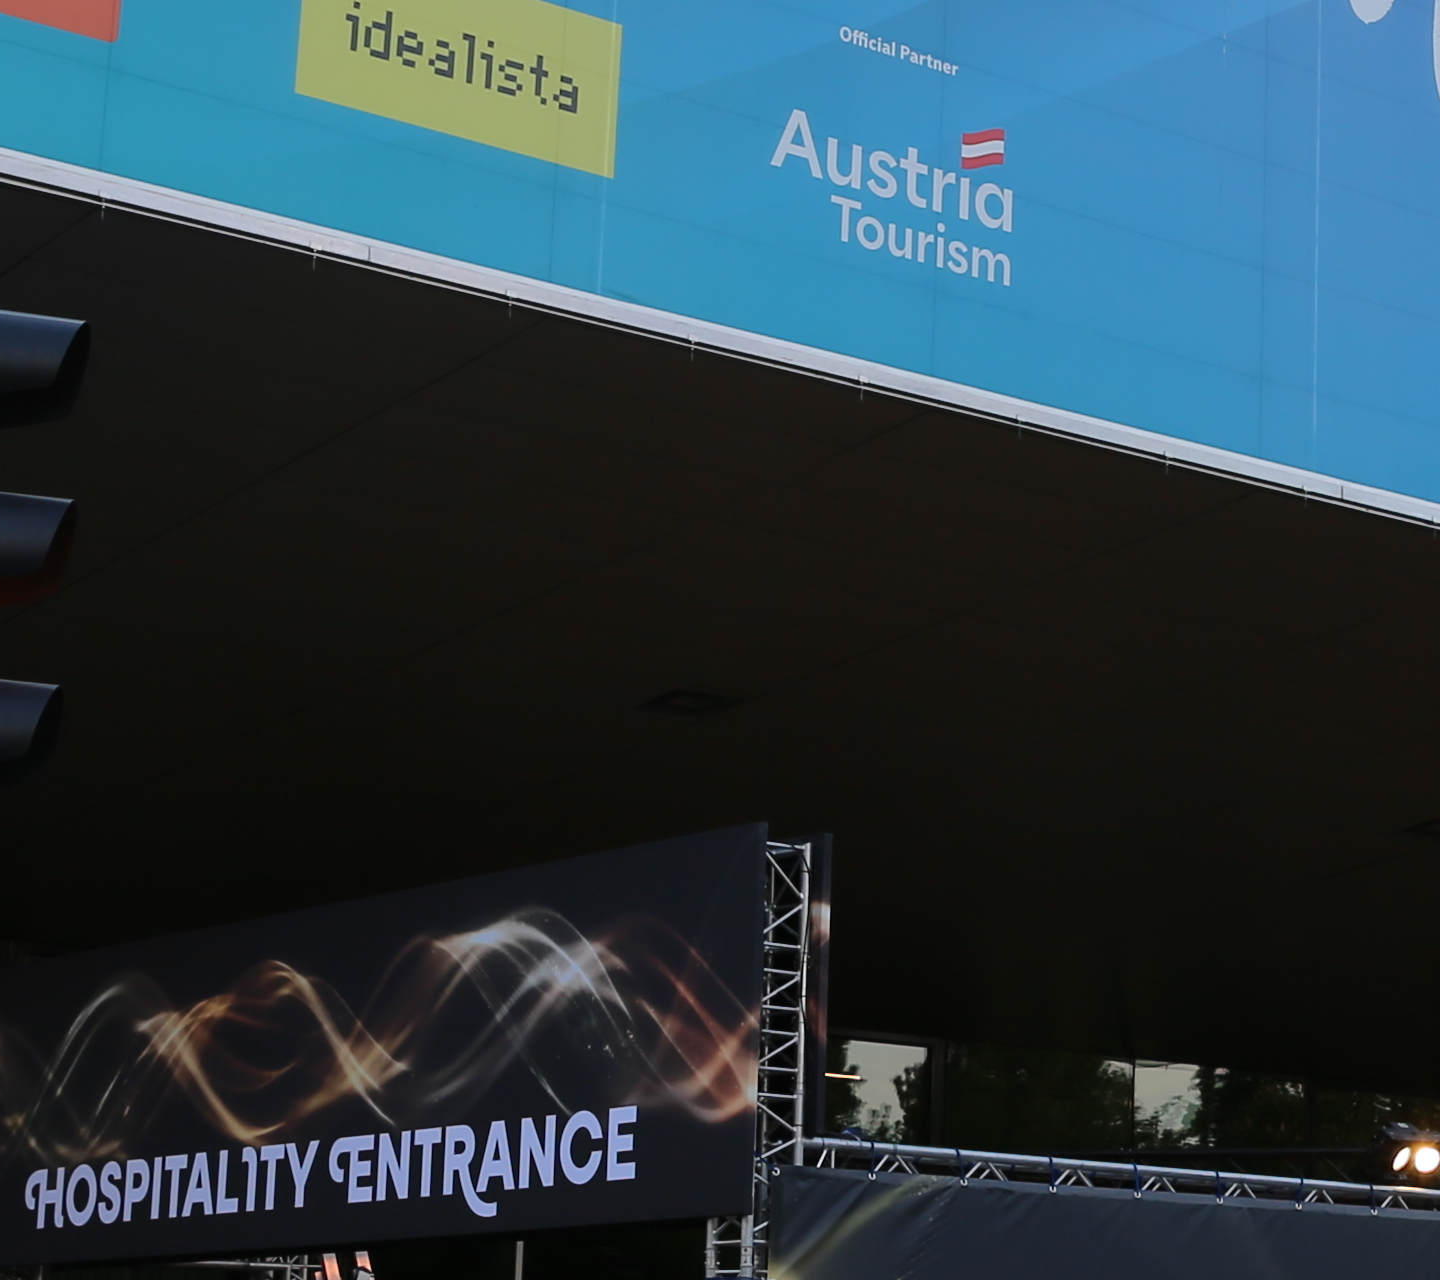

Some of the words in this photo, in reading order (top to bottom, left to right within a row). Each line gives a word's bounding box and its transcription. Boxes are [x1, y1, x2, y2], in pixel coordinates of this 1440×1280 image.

[345, 1, 581, 114] idealista
[838, 24, 897, 62] Official
[899, 42, 960, 78] Partner
[768, 108, 1016, 234] Austria
[830, 193, 1013, 288] Tourism
[24, 1139, 321, 1231] HOSPITALITY
[329, 1104, 639, 1218] ENTRANCE
